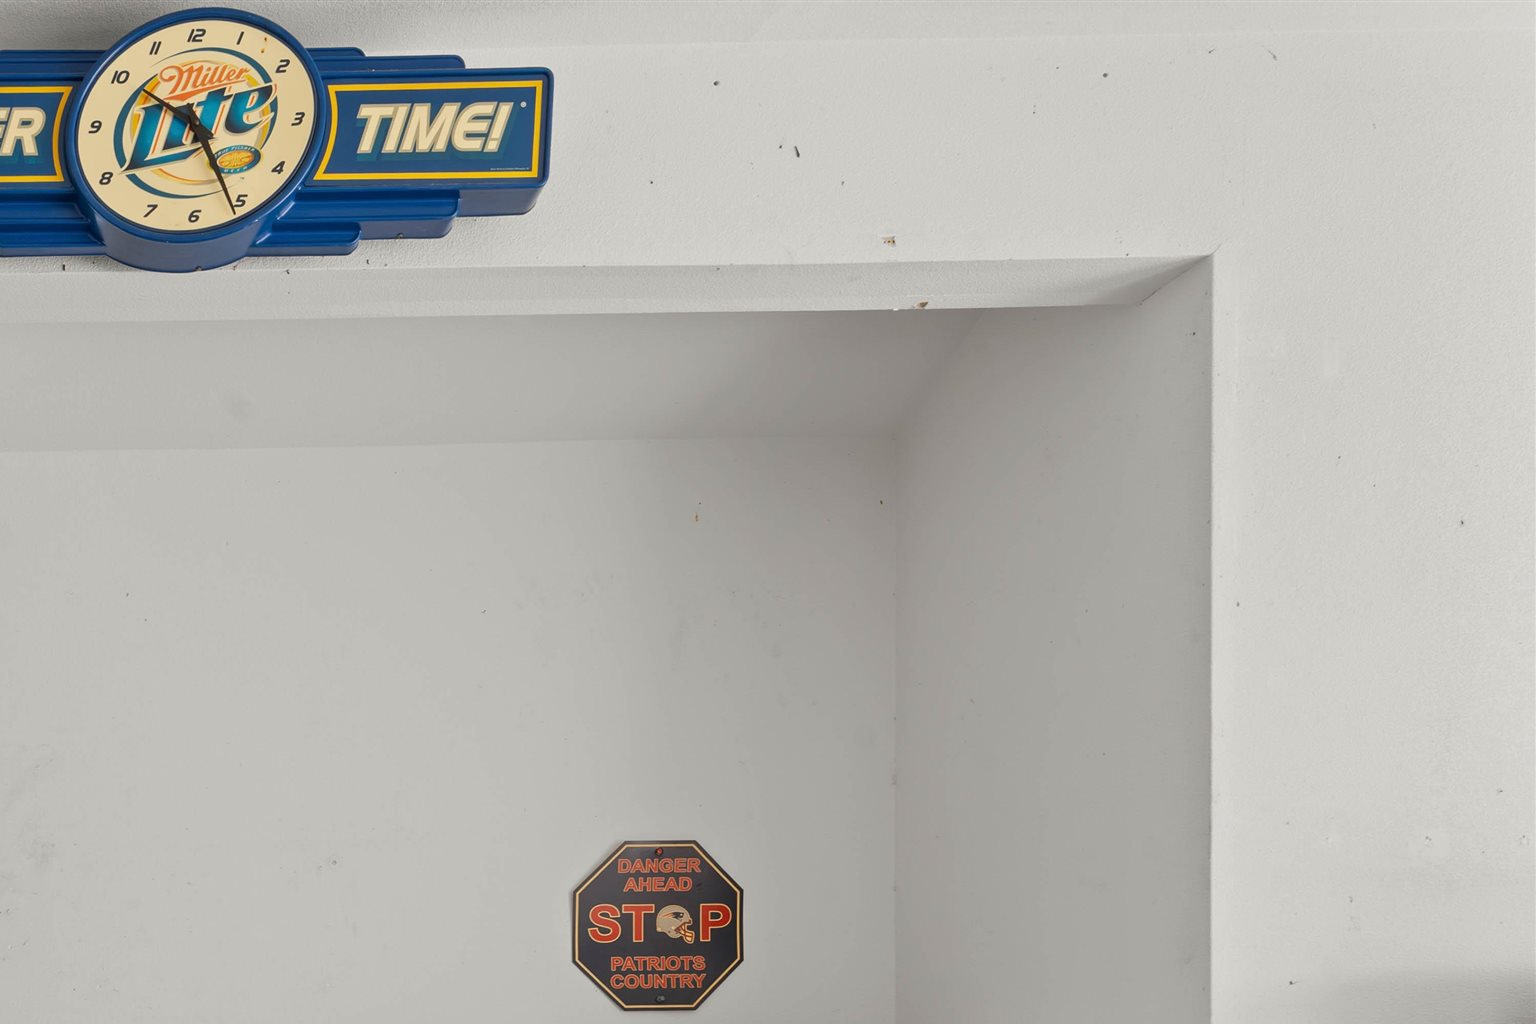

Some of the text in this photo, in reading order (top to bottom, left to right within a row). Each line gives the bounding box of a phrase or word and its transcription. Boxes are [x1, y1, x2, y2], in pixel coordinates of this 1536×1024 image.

[187, 28, 206, 42] 12
[236, 31, 244, 45] 1
[149, 41, 162, 55] 11
[275, 59, 290, 73] 2
[111, 70, 130, 84] 10
[159, 64, 250, 97] Miller
[291, 112, 305, 126] 3
[88, 120, 102, 134] 9
[120, 81, 278, 173] Lite
[356, 101, 514, 153] TIME!
[271, 161, 285, 174] 4
[99, 172, 113, 185] 8
[233, 194, 248, 207] 5
[143, 204, 158, 217] 7
[188, 210, 201, 222] 6
[617, 858, 701, 873] DANGER
[623, 877, 693, 892] AHEAD
[610, 956, 706, 971] PATRIOTS
[610, 974, 707, 990] COUNTRY
